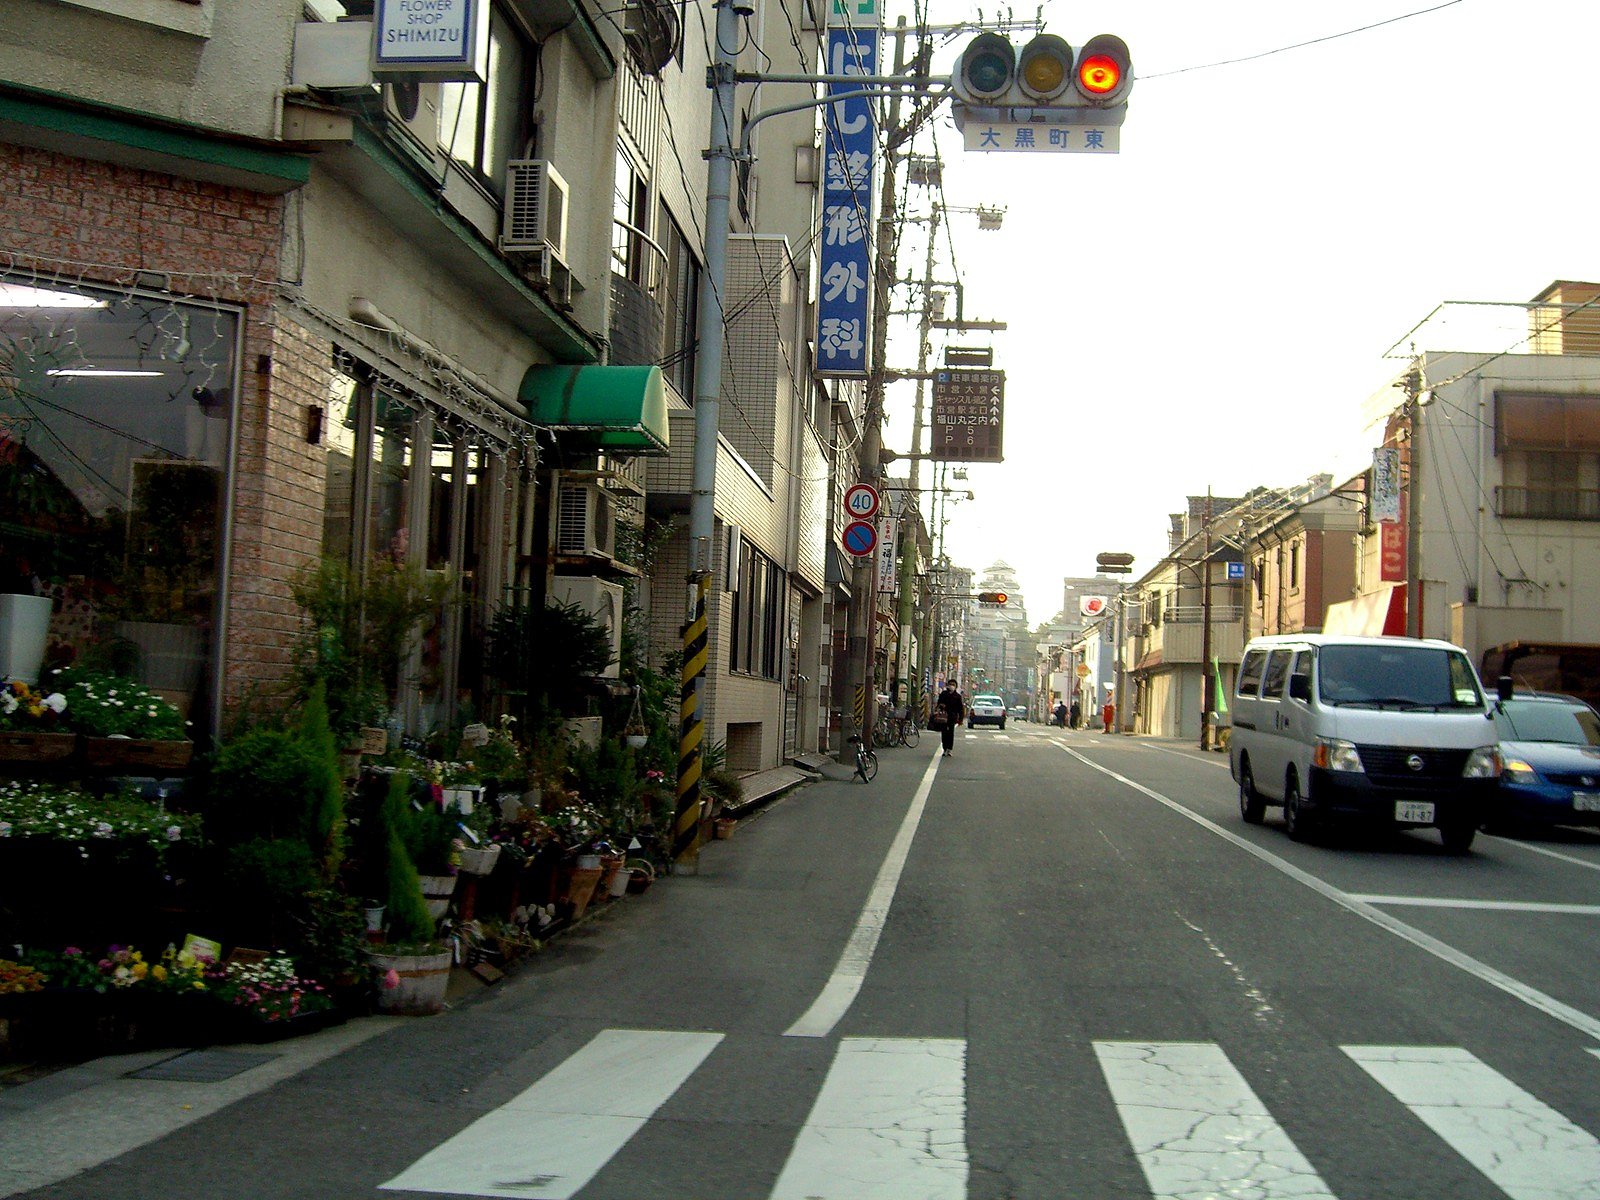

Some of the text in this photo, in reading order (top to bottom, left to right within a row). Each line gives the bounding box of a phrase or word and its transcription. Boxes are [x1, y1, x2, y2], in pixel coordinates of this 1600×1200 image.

[400, 0, 452, 11] FLOWER
[407, 13, 443, 24] SHOP
[386, 28, 460, 42] SHIMIZU
[980, 127, 1104, 149] 大黒町東
[937, 415, 988, 425] 福山丸之内
[852, 494, 871, 510] 40
